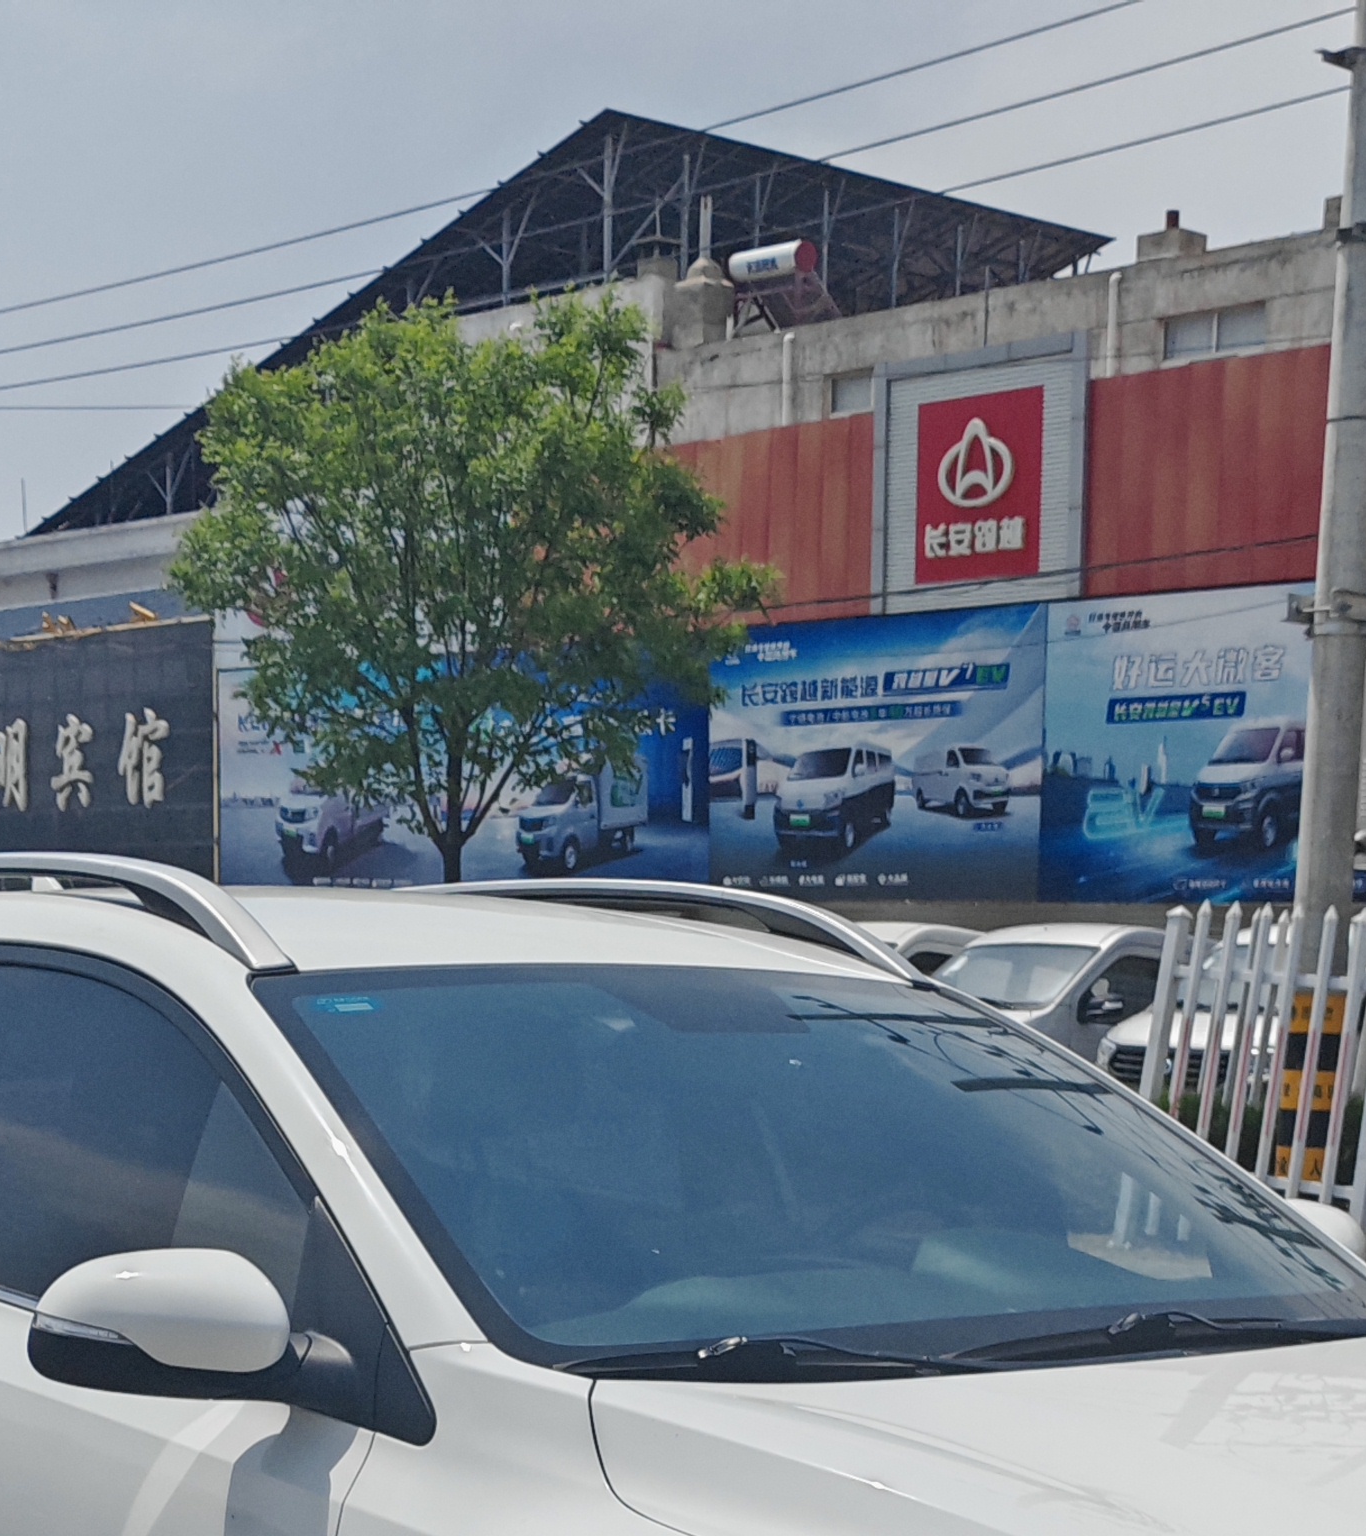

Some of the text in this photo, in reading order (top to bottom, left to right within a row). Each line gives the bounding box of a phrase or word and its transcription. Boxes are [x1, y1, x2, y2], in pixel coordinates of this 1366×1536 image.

[1111, 645, 1285, 692] 好运大微客
